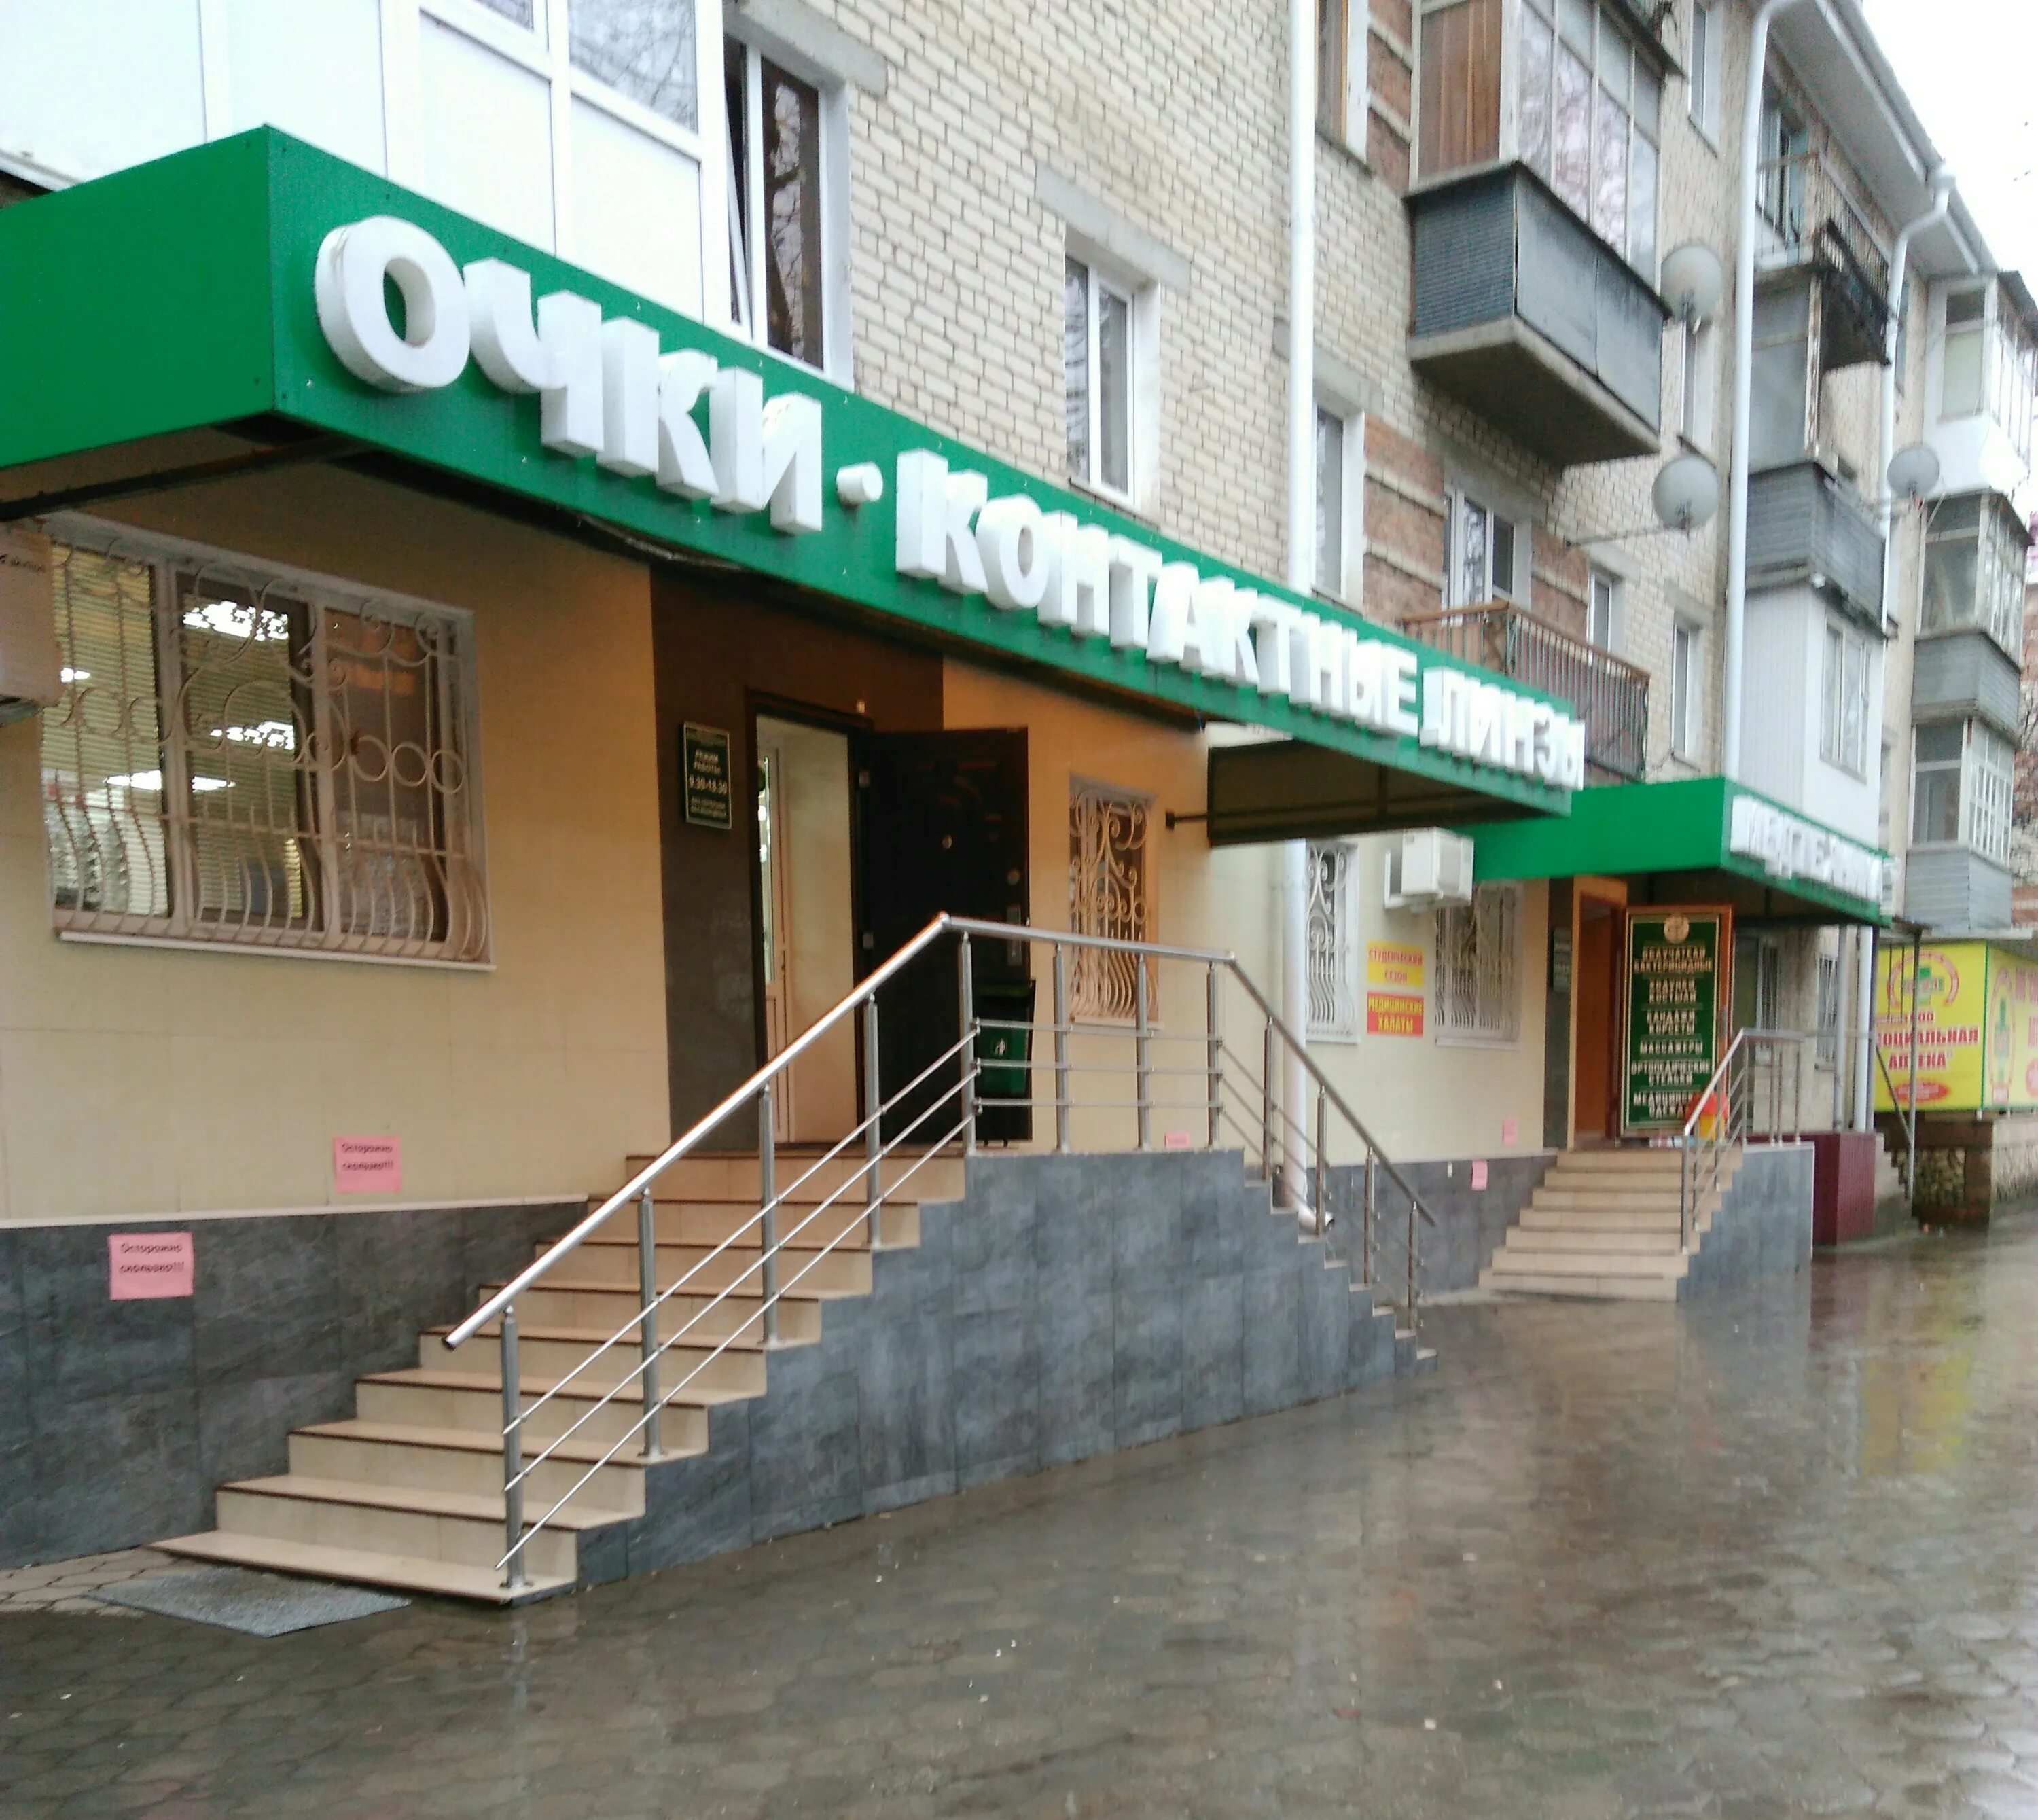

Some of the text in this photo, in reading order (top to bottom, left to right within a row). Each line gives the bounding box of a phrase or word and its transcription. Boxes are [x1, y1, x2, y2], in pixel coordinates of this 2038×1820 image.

[315, 215, 1585, 791] ОЧКИ КОНТАКТНЫЕ ЛИНЗЫ
[1640, 1039, 1703, 1055] МАССАЖЕРЫ
